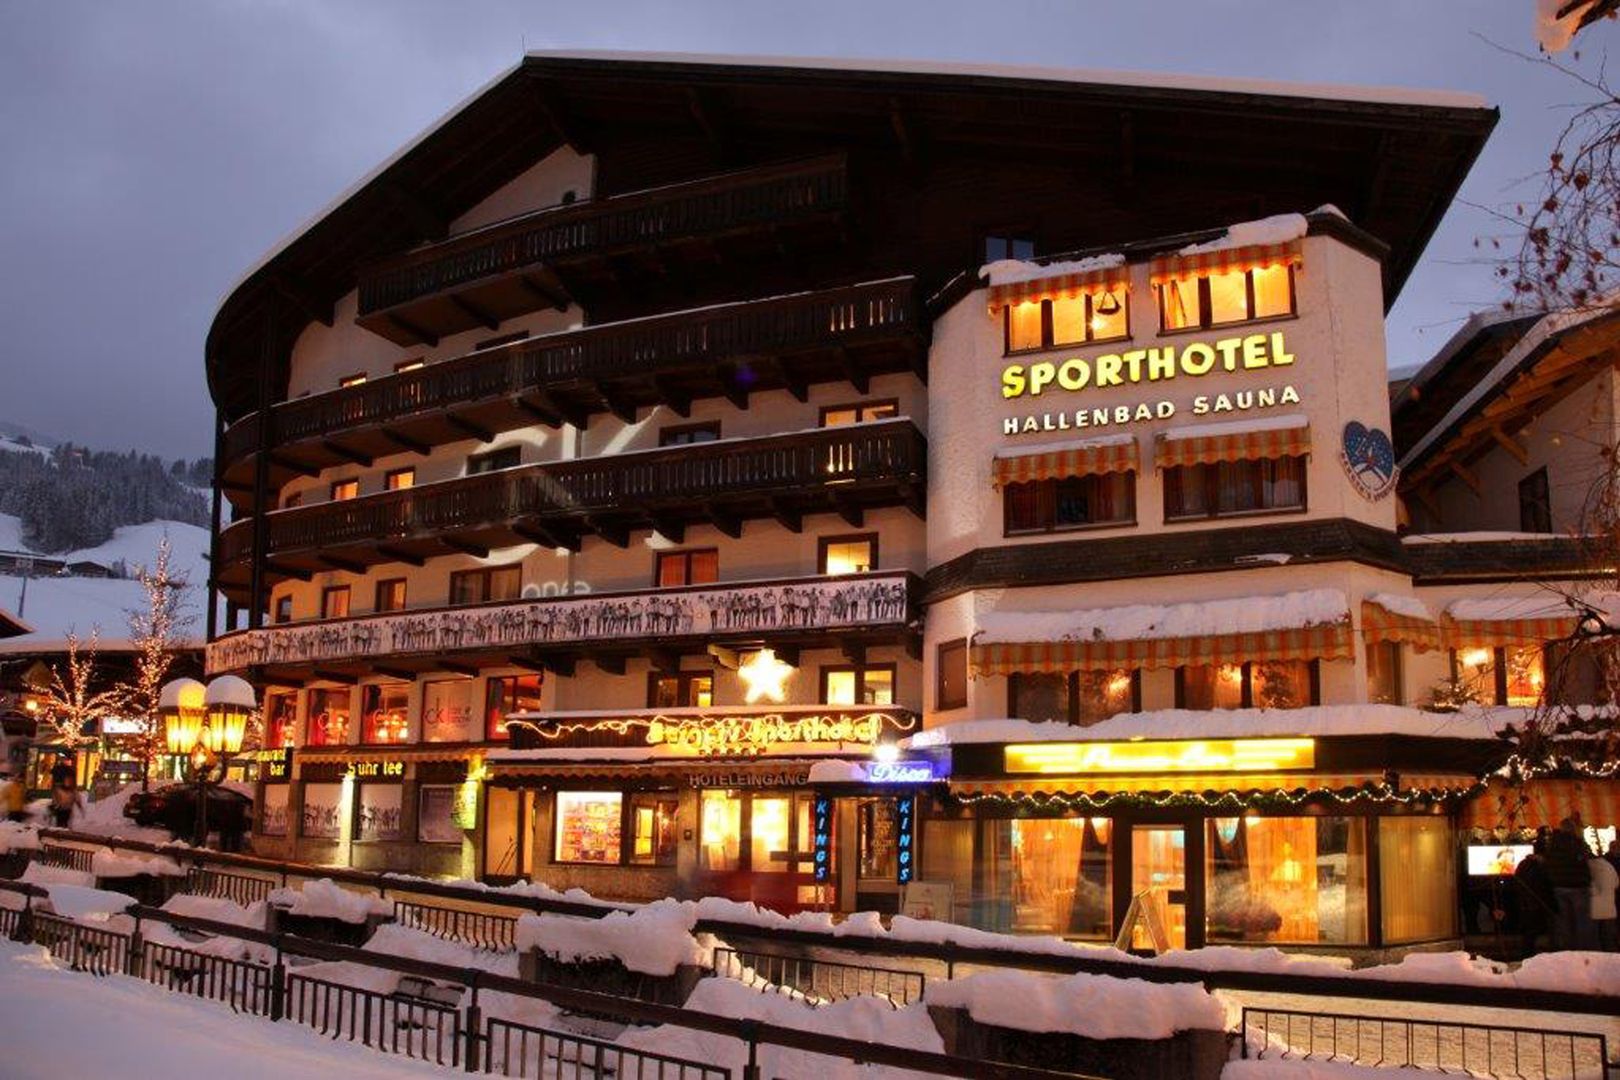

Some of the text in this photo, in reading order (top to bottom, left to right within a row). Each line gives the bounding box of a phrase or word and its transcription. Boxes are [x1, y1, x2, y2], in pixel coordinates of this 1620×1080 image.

[1002, 331, 1295, 398] SPORTHOTEL
[1003, 384, 1300, 435] HALLENBAD SAUNA
[269, 761, 286, 776] bar
[357, 761, 378, 776] uhr
[383, 761, 404, 775] tee
[688, 773, 809, 787] HOTELEINGANG
[815, 800, 829, 879] KINGS
[899, 800, 912, 881] KINGS
